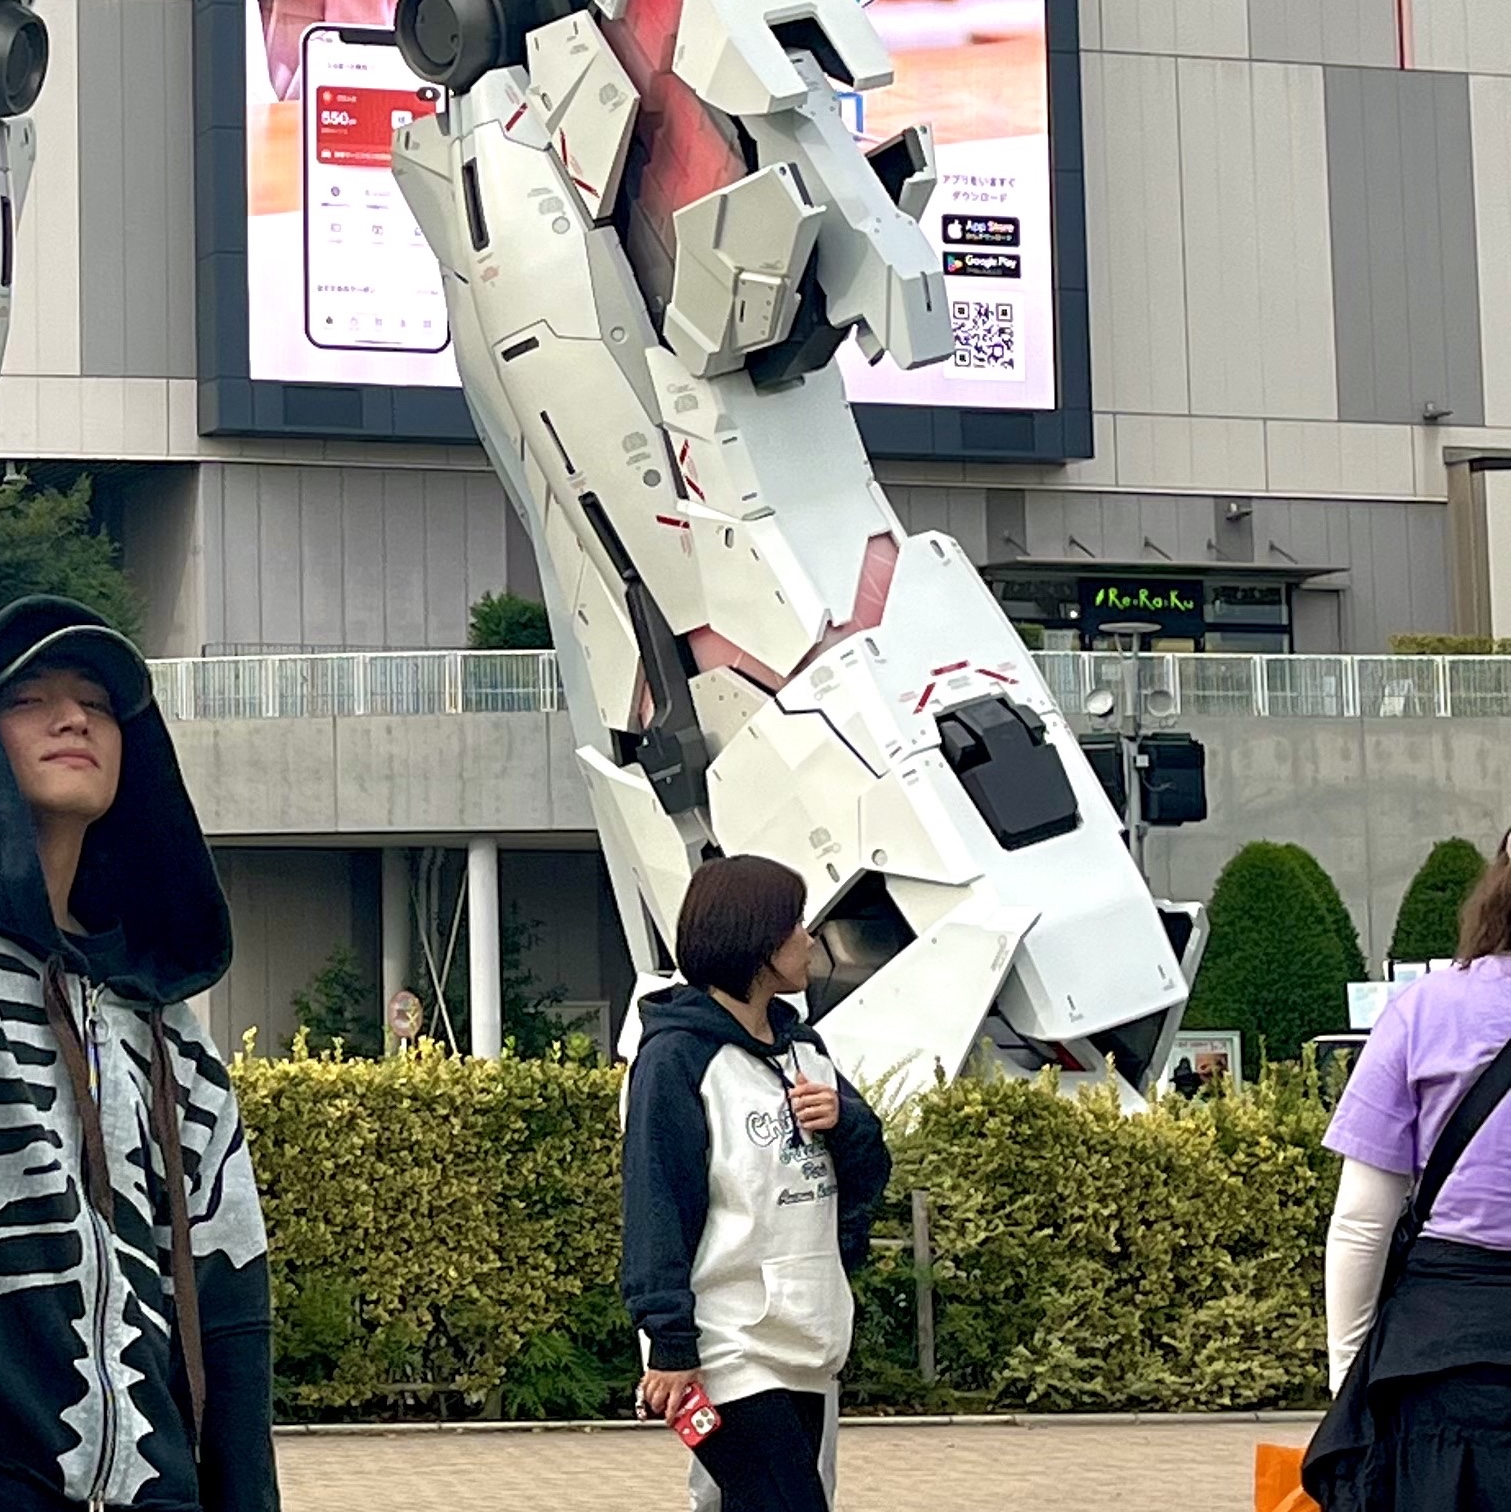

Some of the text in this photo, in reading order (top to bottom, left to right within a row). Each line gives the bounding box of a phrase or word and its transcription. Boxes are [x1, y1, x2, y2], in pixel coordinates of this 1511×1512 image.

[952, 190, 1008, 203] ダウンロード
[965, 219, 986, 233] App
[965, 254, 1017, 270] Google Play
